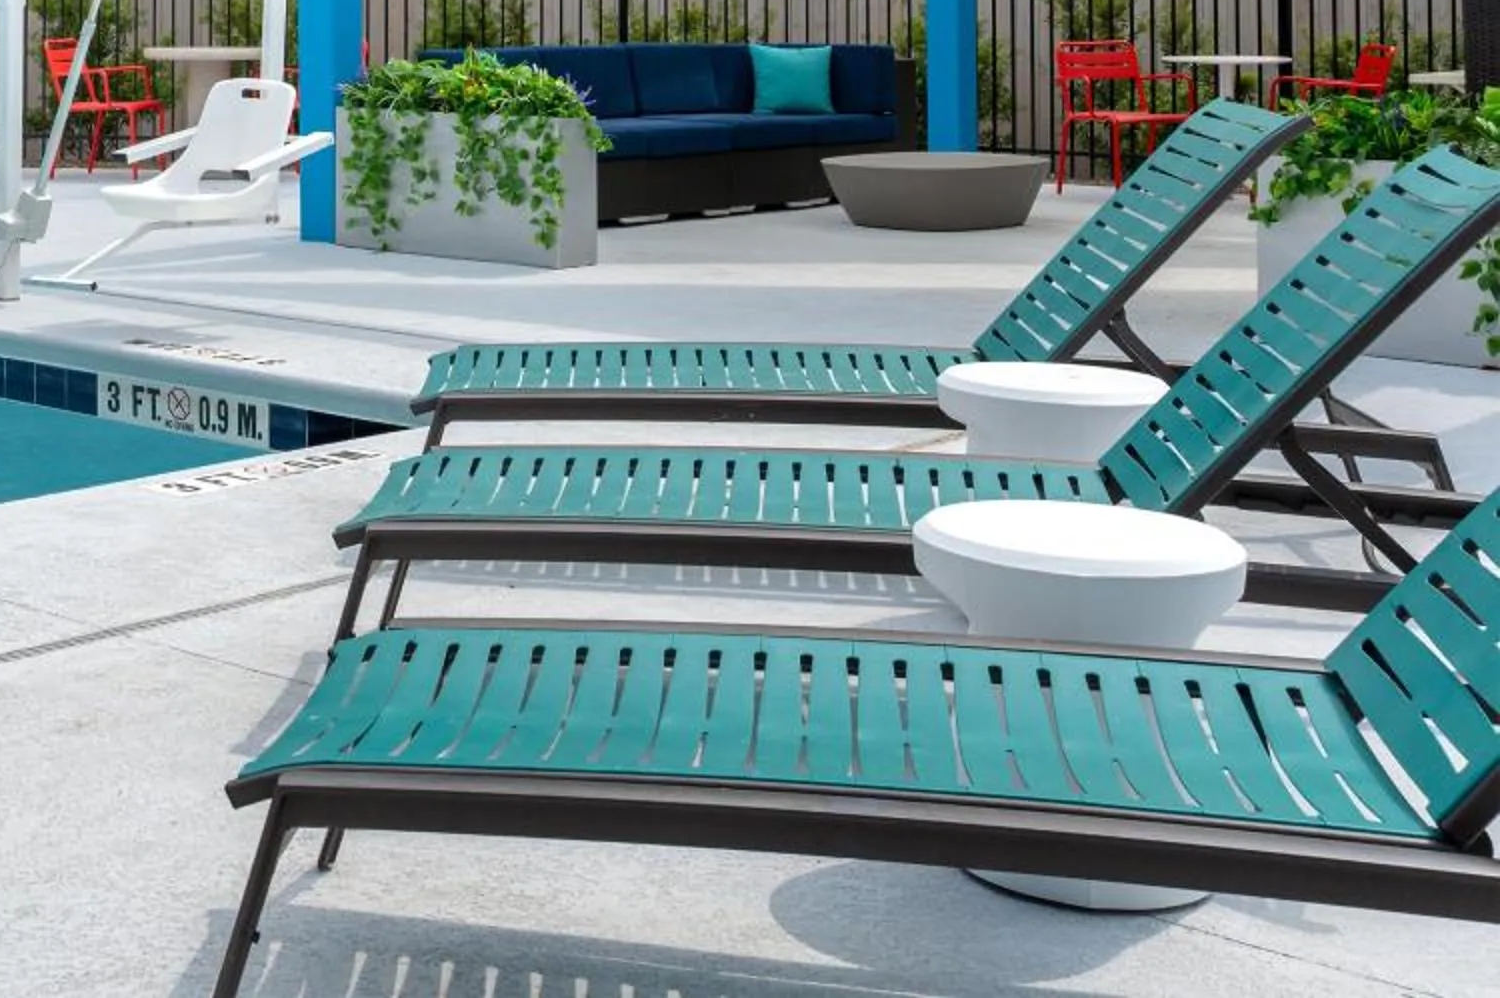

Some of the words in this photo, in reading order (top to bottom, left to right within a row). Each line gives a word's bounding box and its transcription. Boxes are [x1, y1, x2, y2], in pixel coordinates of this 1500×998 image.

[107, 381, 120, 413] 3
[132, 385, 161, 422] FT.
[199, 395, 229, 434] 0.9
[237, 402, 263, 440] M.
